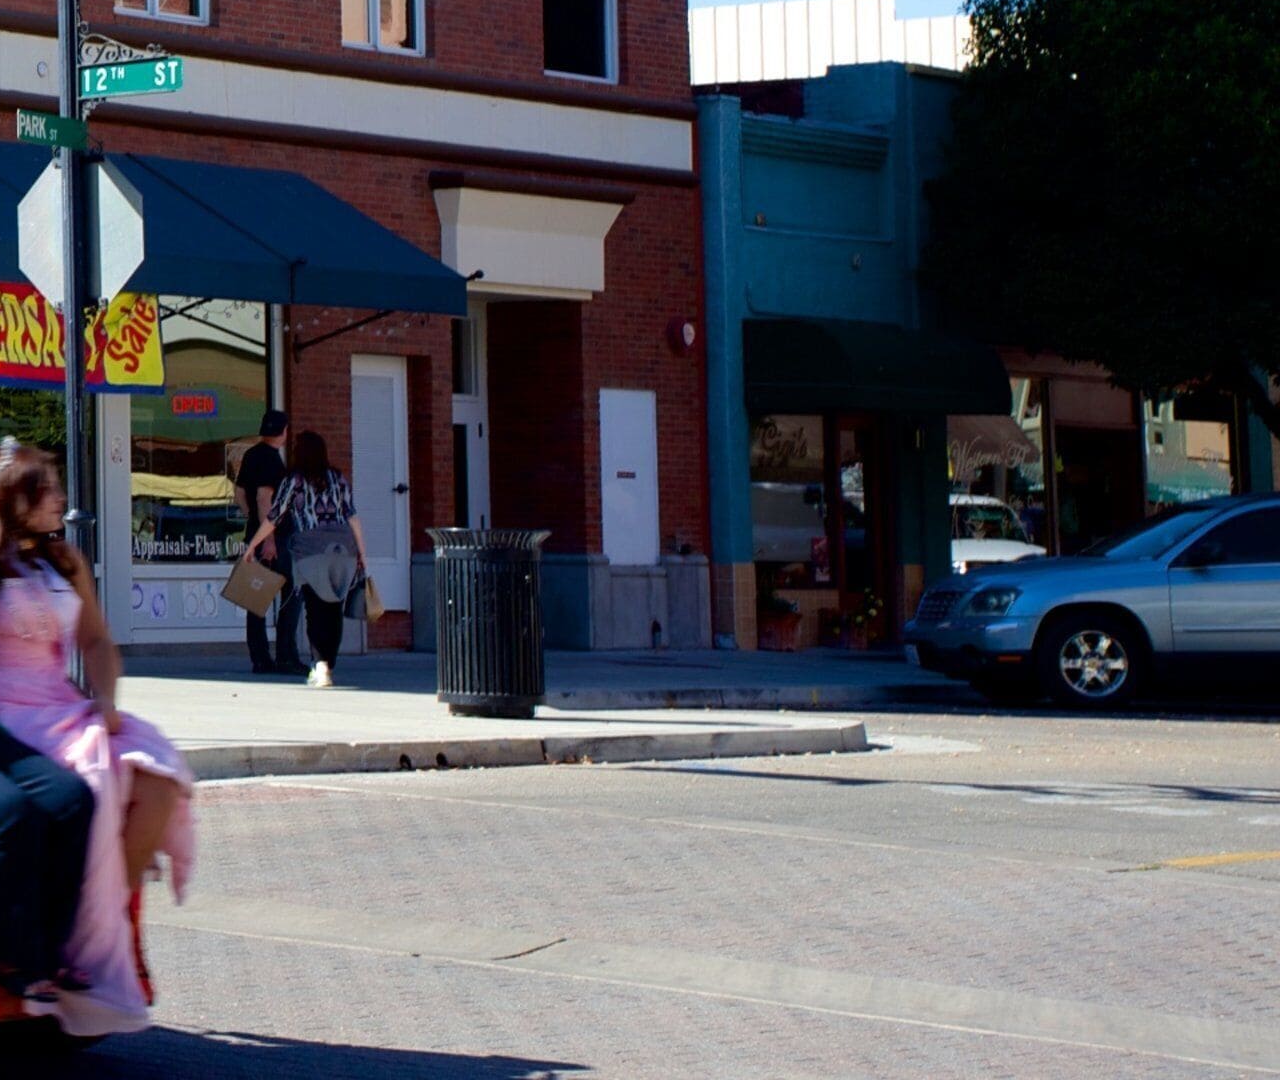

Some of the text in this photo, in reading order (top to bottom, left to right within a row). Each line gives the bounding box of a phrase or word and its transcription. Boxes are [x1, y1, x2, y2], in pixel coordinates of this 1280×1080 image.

[83, 61, 179, 92] 12TH ST
[18, 113, 58, 141] PARK ST
[106, 296, 159, 374] Sale
[171, 395, 215, 414] OPEN
[132, 534, 221, 560] Appraisals-Ebay
